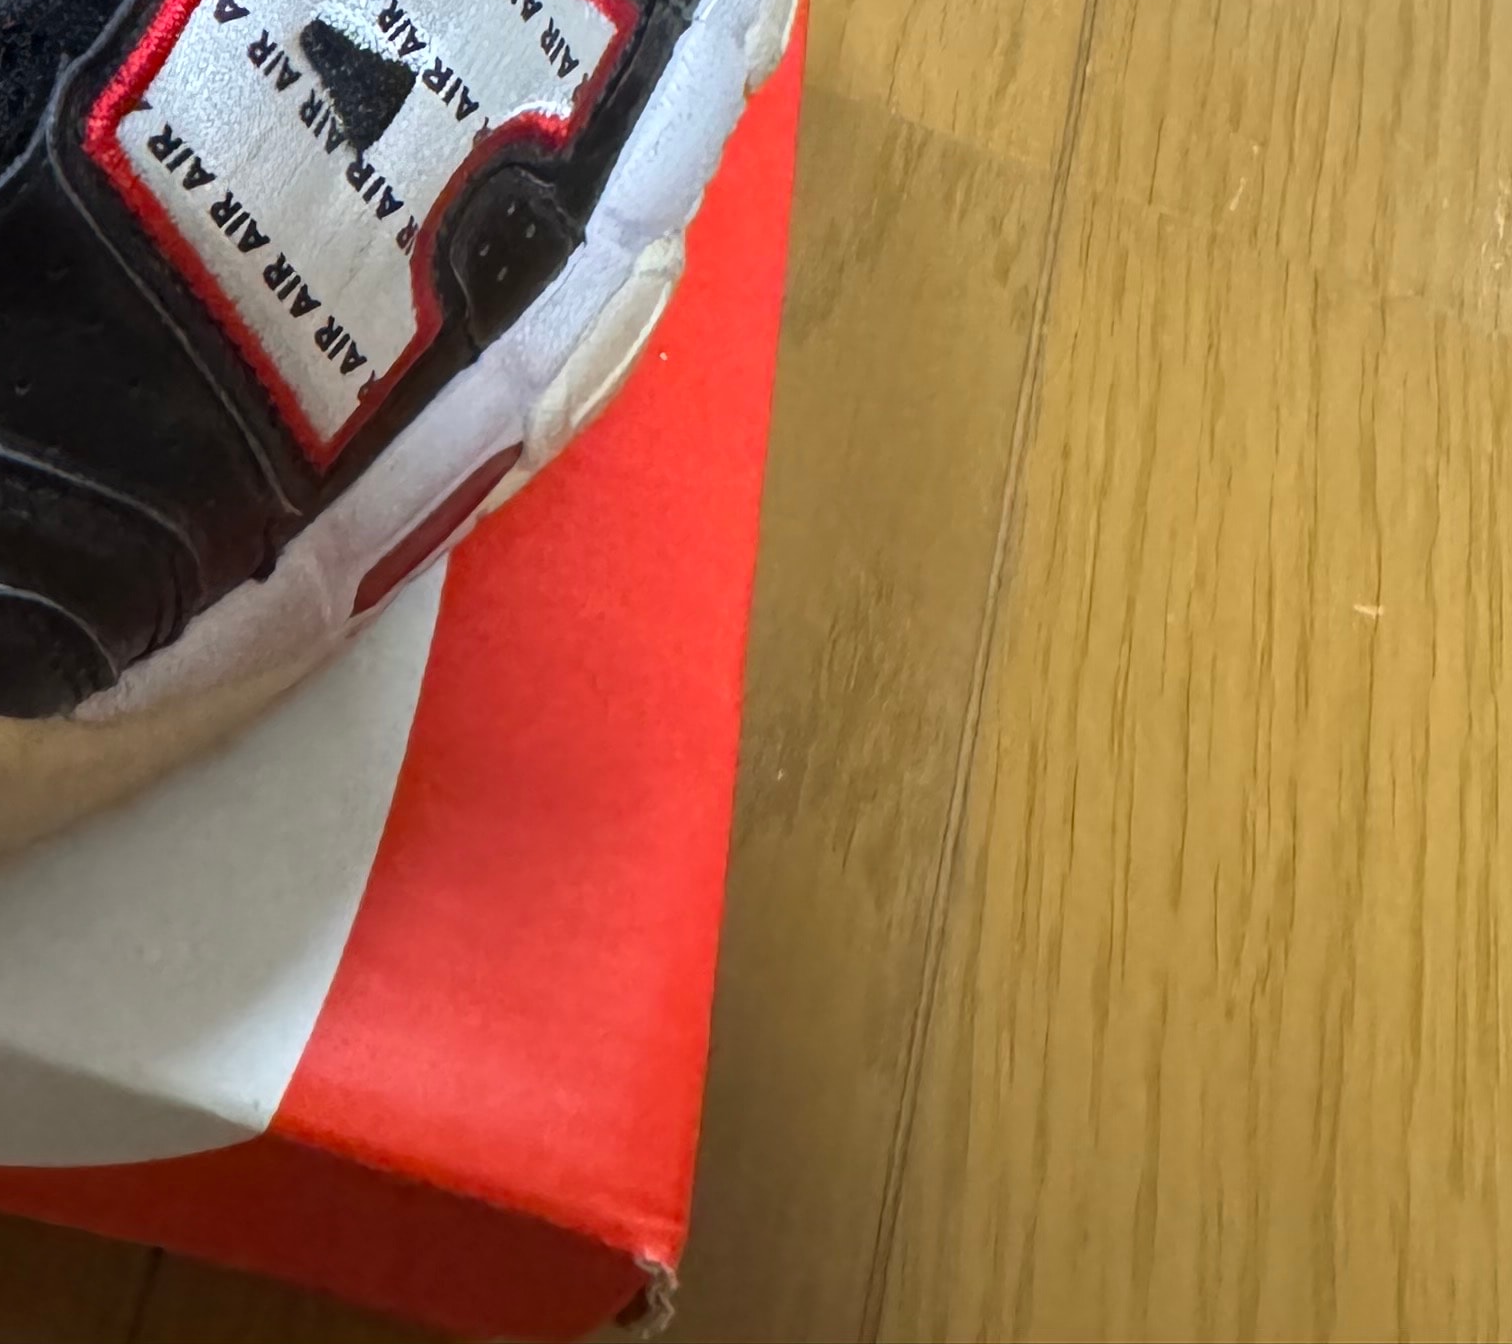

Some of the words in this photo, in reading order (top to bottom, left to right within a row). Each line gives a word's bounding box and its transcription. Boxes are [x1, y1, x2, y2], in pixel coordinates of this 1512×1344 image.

[246, 28, 303, 93] AIR
[540, 16, 580, 79] AIR
[299, 87, 345, 156] AIR
[421, 55, 480, 123] AIR
[146, 121, 218, 191] AIR
[345, 148, 405, 221] AIR
[208, 188, 271, 254] AIR
[262, 251, 322, 319] AIR
[313, 314, 368, 376] AIR
